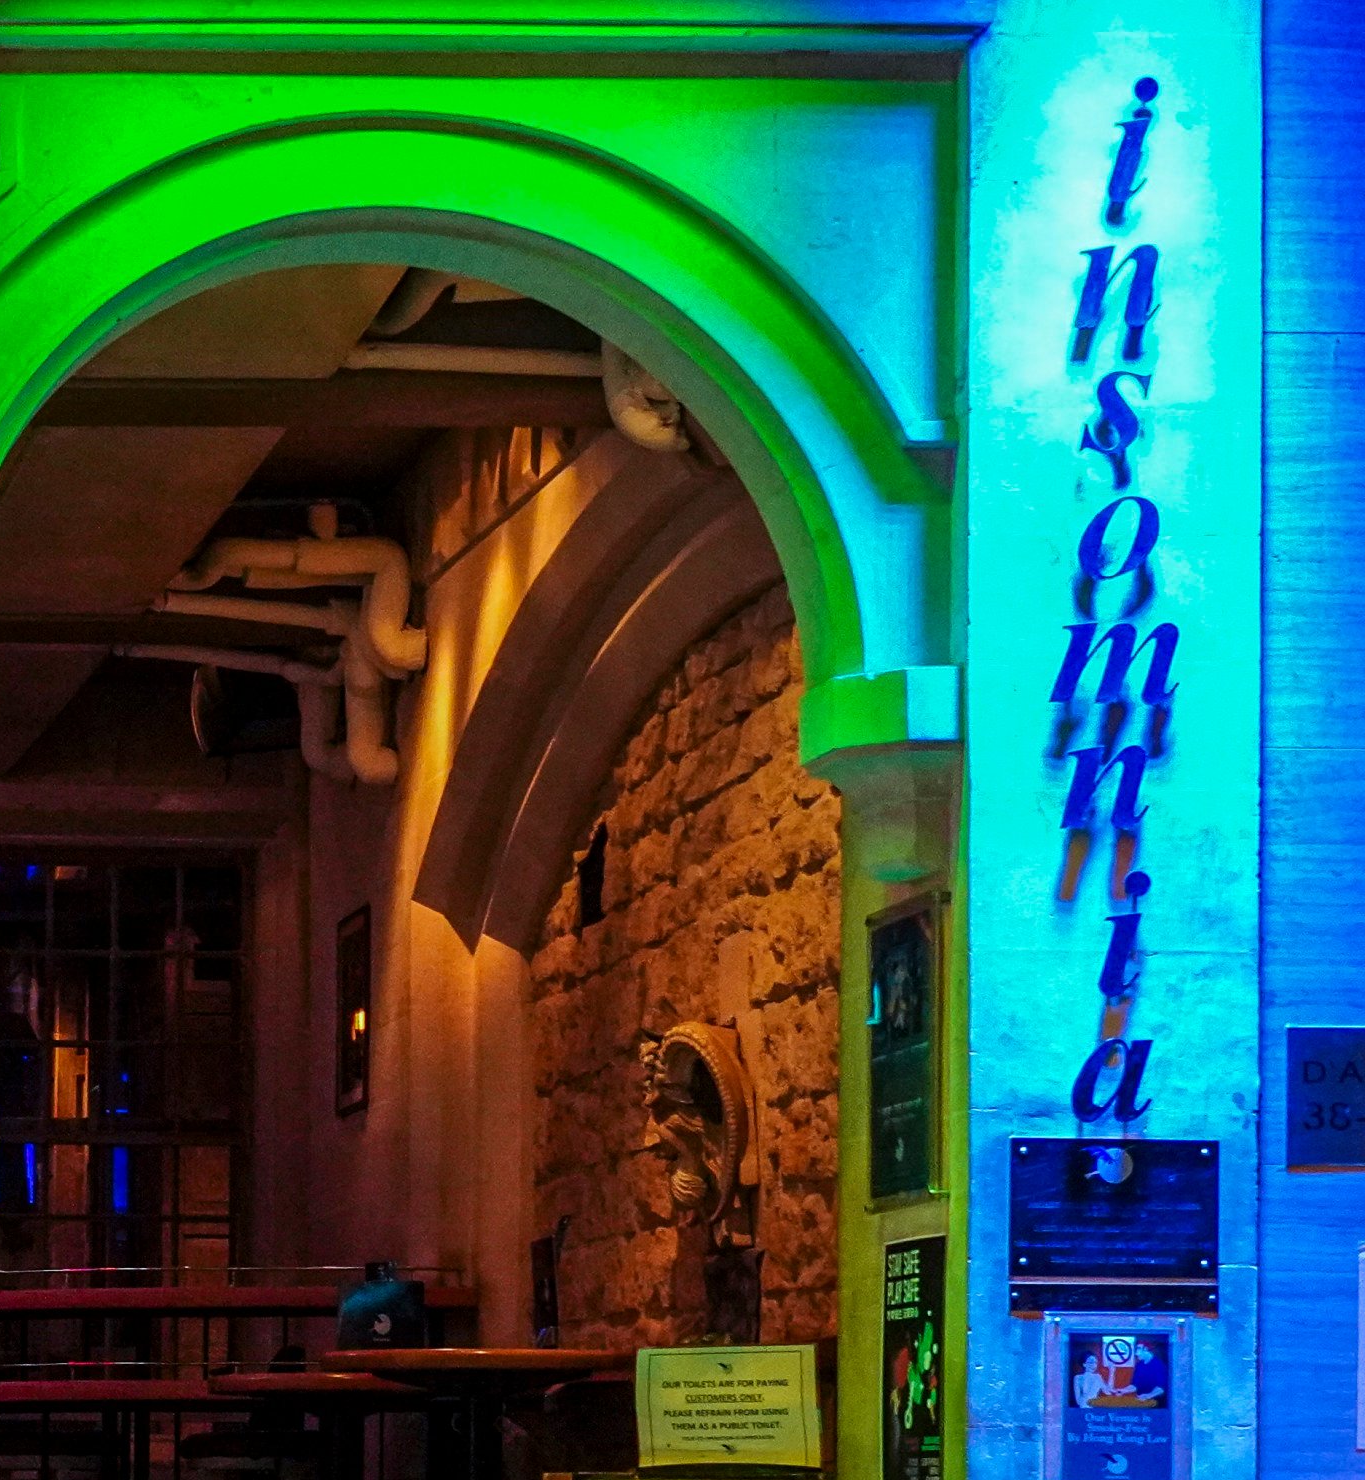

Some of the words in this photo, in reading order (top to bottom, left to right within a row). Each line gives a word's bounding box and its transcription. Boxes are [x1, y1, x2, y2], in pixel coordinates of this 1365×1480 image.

[1049, 77, 1180, 1123] insomnia
[662, 1380, 681, 1389] OUR
[683, 1380, 716, 1389] TOILETS
[719, 1379, 734, 1388] ARE
[737, 1379, 754, 1388] FOR
[756, 1379, 789, 1388] PAYING
[685, 1394, 737, 1403] CUSTOMERS
[663, 1410, 693, 1418] PLEASE
[695, 1409, 732, 1417] REFRAIN
[762, 1408, 789, 1416] USING
[672, 1422, 696, 1431] THEM
[699, 1422, 710, 1431] AS
[720, 1422, 749, 1430] PUBLIC
